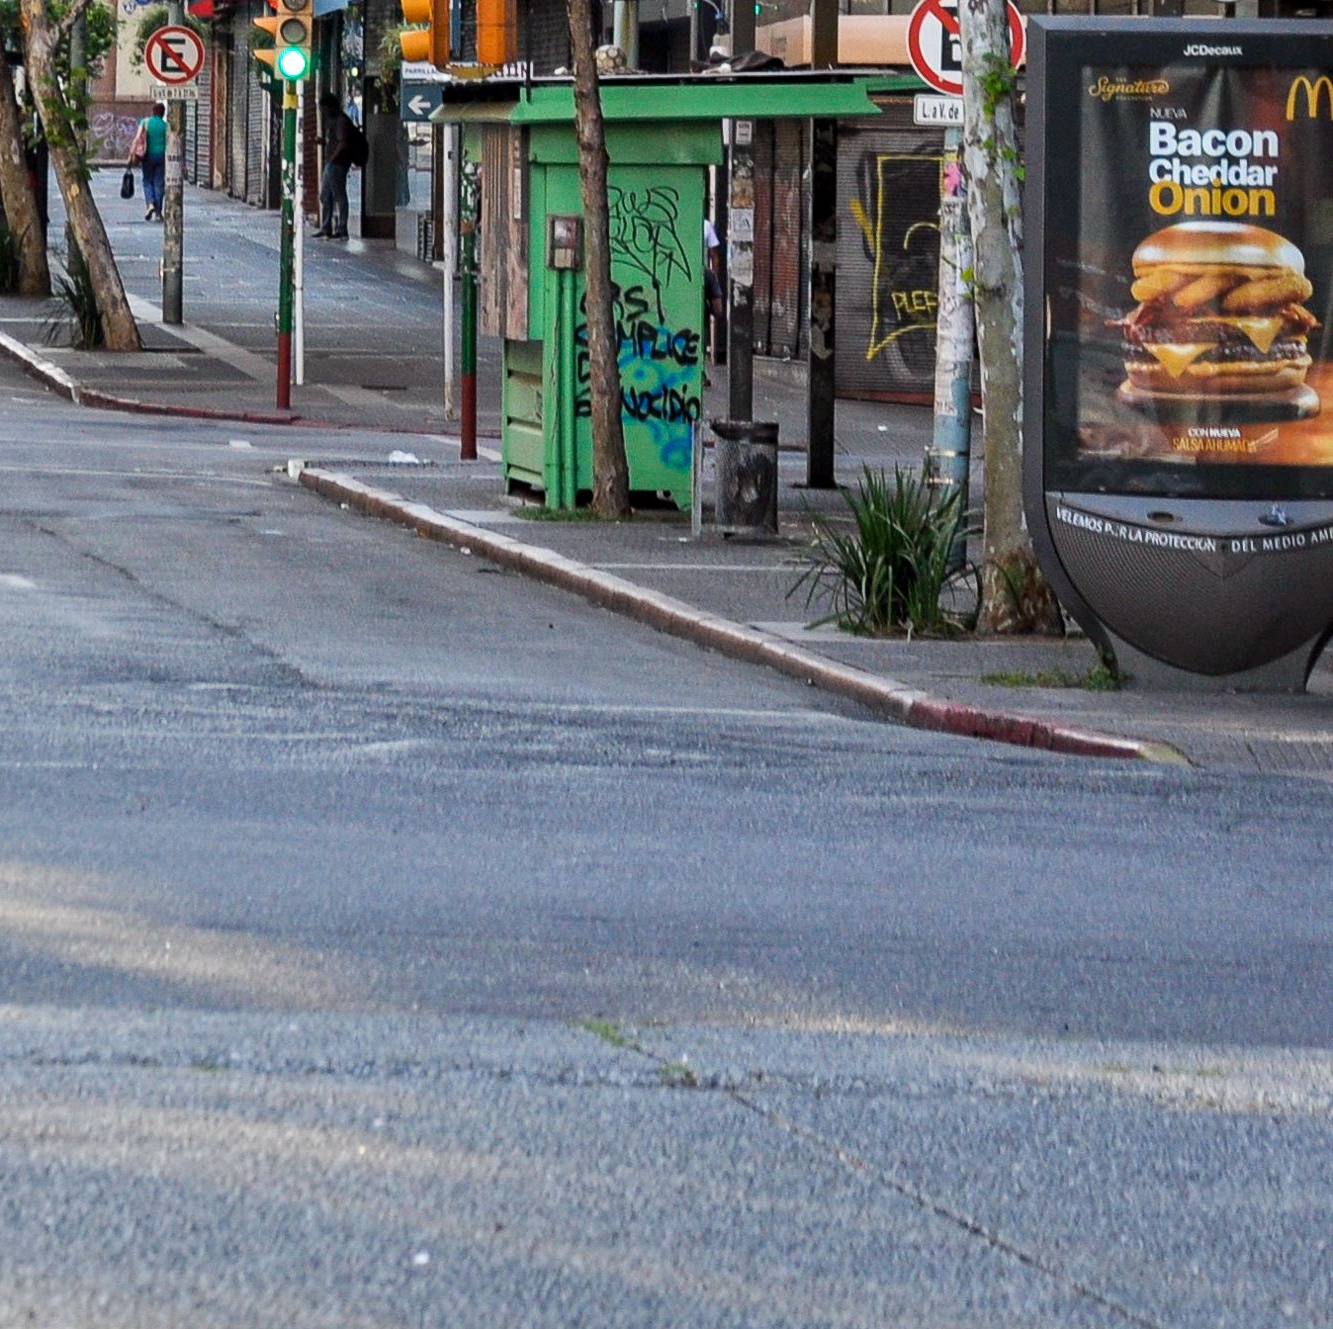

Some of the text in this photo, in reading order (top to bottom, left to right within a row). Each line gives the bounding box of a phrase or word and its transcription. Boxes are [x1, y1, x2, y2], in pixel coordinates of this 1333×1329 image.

[1183, 44, 1243, 56] JCDecaux
[1088, 76, 1170, 102] Signature
[1150, 107, 1188, 120] NUEVA
[1149, 121, 1279, 157] Bacon
[1148, 158, 1278, 186] Cheddar
[1148, 176, 1277, 216] Onion
[1172, 437, 1205, 452] SALSA
[1231, 538, 1257, 553] DEL
[1262, 533, 1306, 552] MEDIO
